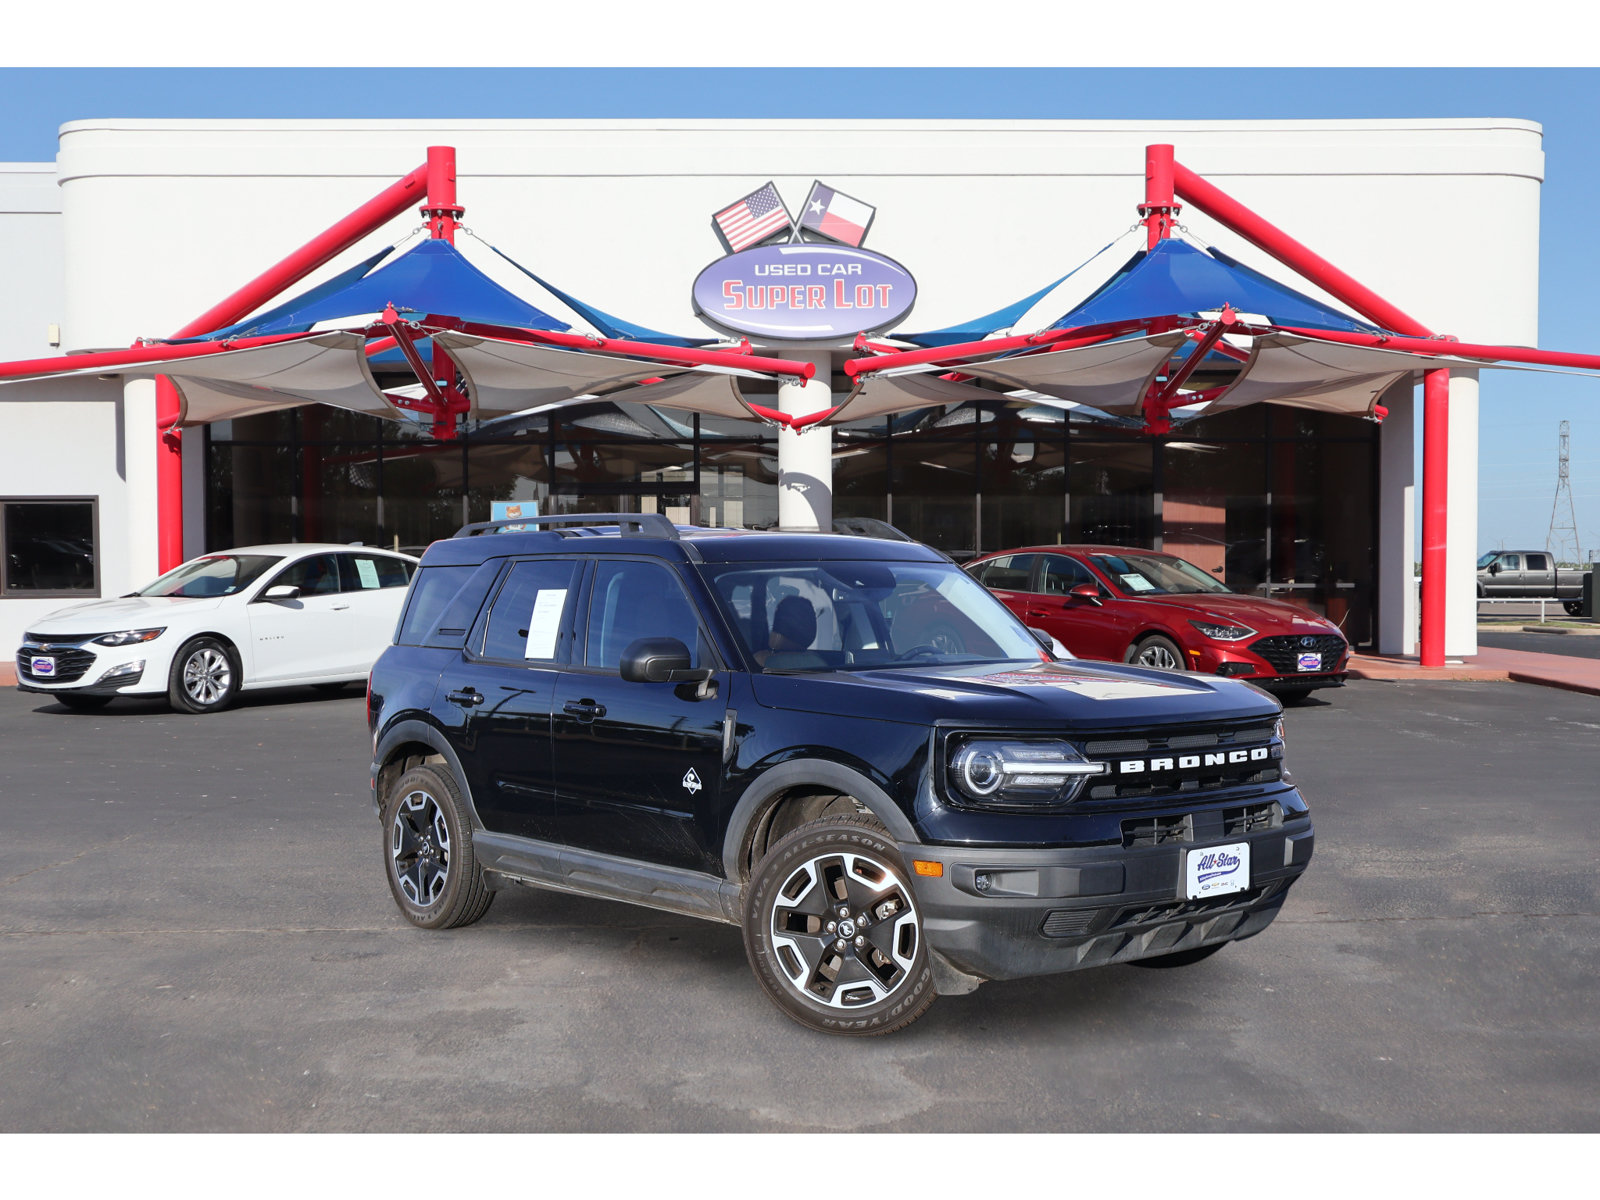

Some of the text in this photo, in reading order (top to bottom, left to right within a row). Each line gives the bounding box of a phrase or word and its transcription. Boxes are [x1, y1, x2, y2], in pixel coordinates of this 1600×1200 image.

[754, 263, 862, 276] USED CAR
[722, 278, 893, 310] SUPER LOT
[1120, 748, 1268, 774] BRONCO
